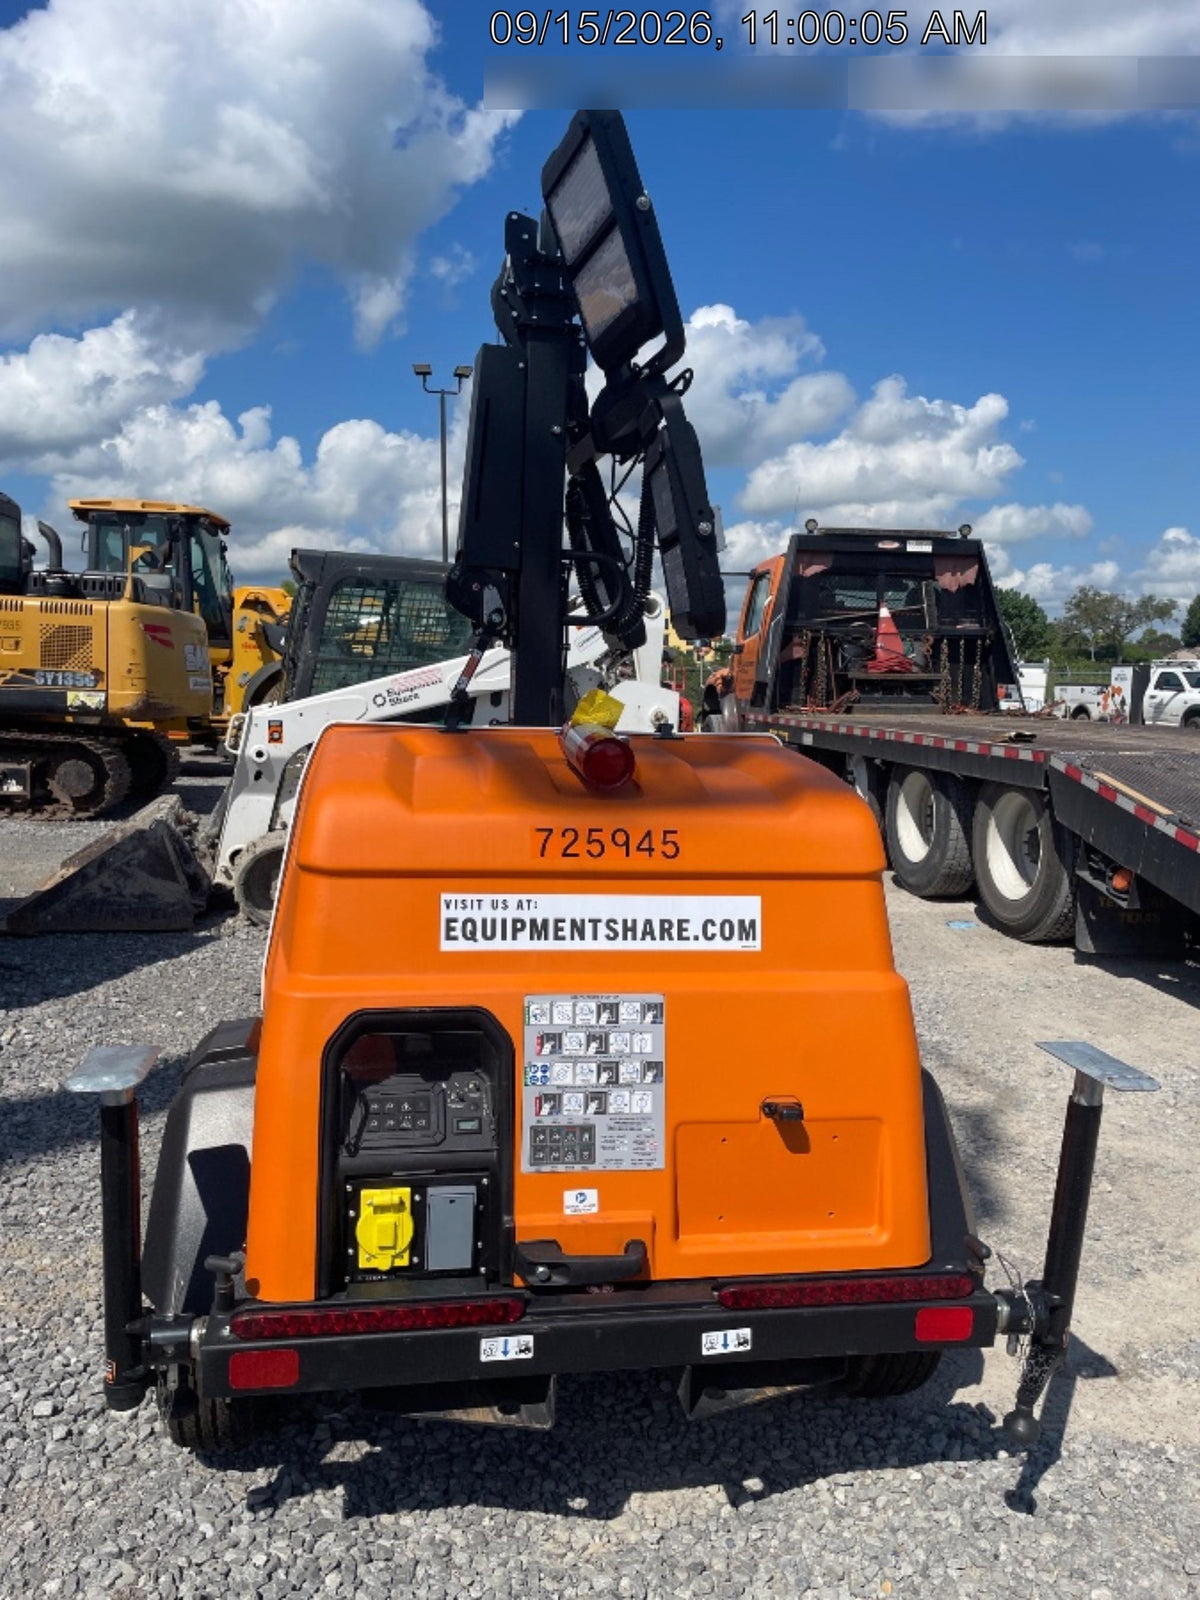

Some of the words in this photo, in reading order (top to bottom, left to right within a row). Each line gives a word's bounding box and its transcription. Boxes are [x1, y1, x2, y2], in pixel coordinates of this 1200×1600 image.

[535, 828, 681, 859] 725945
[444, 899, 483, 911] VISIT
[491, 899, 509, 911] US
[517, 900, 539, 911] AT:
[444, 917, 757, 943] EQUIPMENTSHARE.COM
